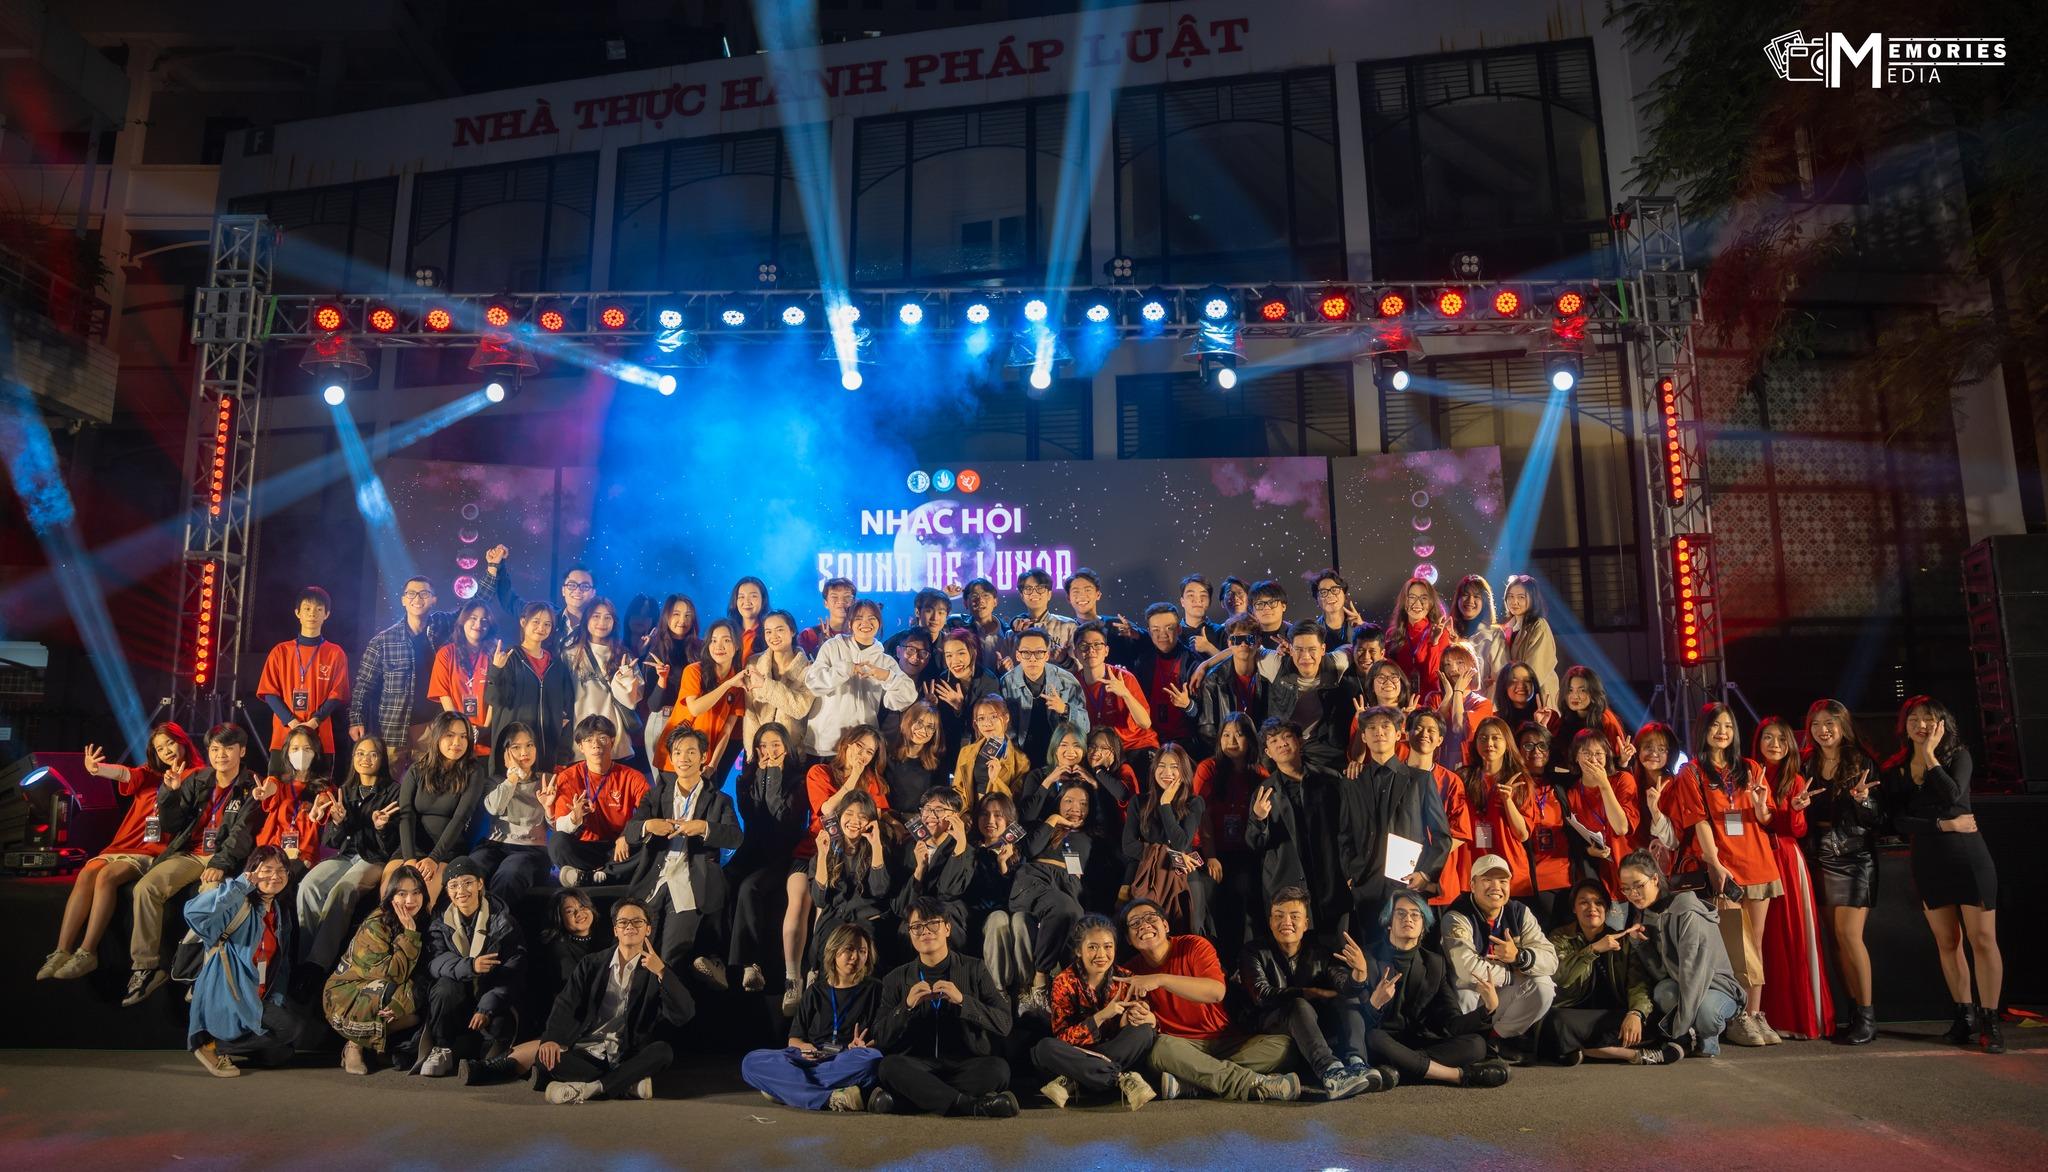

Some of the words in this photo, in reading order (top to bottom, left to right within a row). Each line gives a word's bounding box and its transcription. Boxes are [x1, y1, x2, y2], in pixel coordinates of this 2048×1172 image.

[452, 98, 560, 147] NHÀ
[574, 83, 706, 130] THỰC
[904, 35, 1065, 88] PHÁP
[1083, 14, 1249, 68] LUẬT
[253, 131, 265, 153] F
[861, 508, 954, 541] NHẠC
[961, 503, 1022, 540] HỘI
